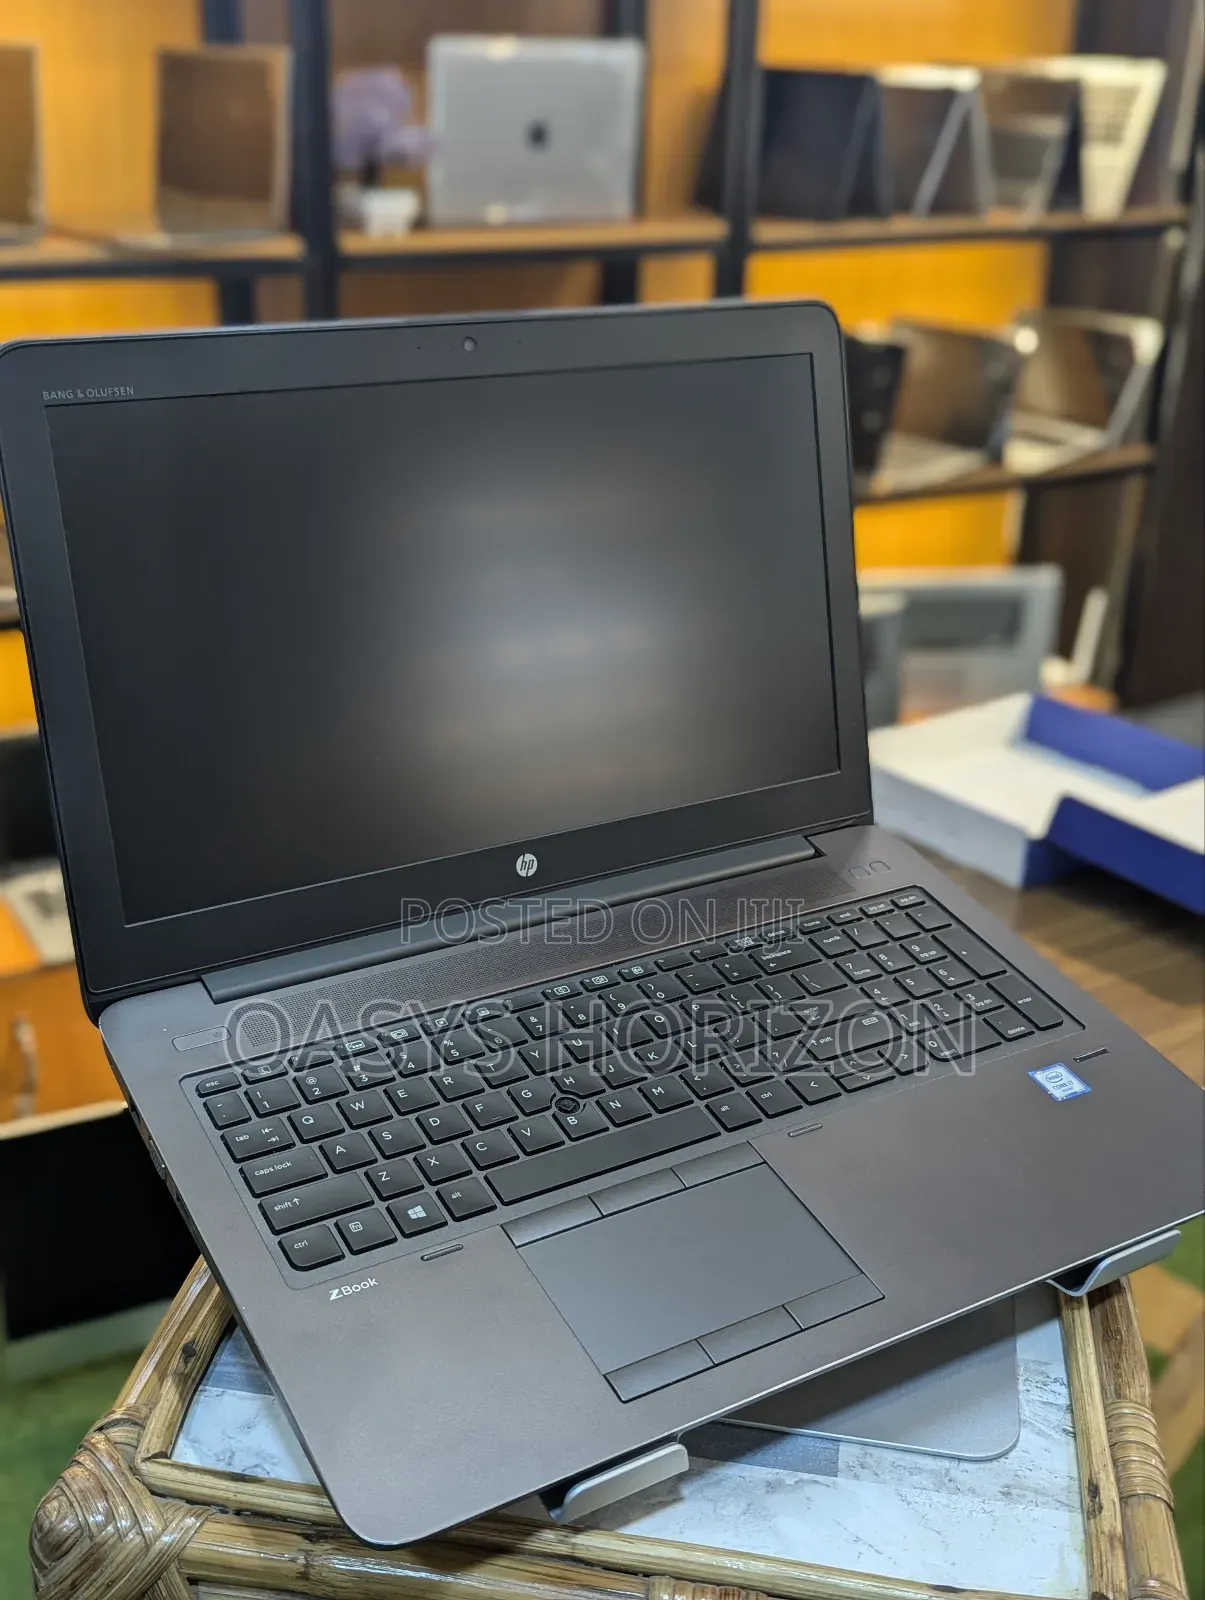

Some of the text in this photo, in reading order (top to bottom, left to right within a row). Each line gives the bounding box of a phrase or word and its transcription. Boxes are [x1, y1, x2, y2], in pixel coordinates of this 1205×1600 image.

[42, 386, 134, 400] BANG & OLUFSEN
[517, 854, 537, 877] hp
[572, 1038, 582, 1046] U
[450, 1049, 460, 1057] 5
[530, 1050, 540, 1058] Y
[647, 1051, 660, 1060] K
[486, 1063, 496, 1072] T
[608, 1064, 615, 1072] J
[306, 1076, 318, 1085] @
[442, 1076, 454, 1086] R
[564, 1076, 576, 1086] H
[396, 1089, 408, 1098] E
[521, 1089, 532, 1098] G
[652, 1086, 664, 1096] M
[350, 1100, 365, 1110] W
[475, 1103, 484, 1112] F
[608, 1100, 622, 1110] N
[302, 1116, 314, 1124] Q
[428, 1117, 440, 1126] D
[566, 1116, 578, 1125] B
[382, 1131, 392, 1140] S
[520, 1127, 531, 1136] V
[336, 1145, 346, 1154] A
[476, 1142, 488, 1151] C
[426, 1156, 440, 1166] X
[254, 1160, 292, 1176] caps lock
[378, 1171, 391, 1182] Z
[452, 1191, 462, 1199] alt
[273, 1200, 292, 1212] shift
[350, 1222, 362, 1232] fn
[294, 1240, 308, 1249] ctrl
[329, 1278, 378, 1300] ZBook
